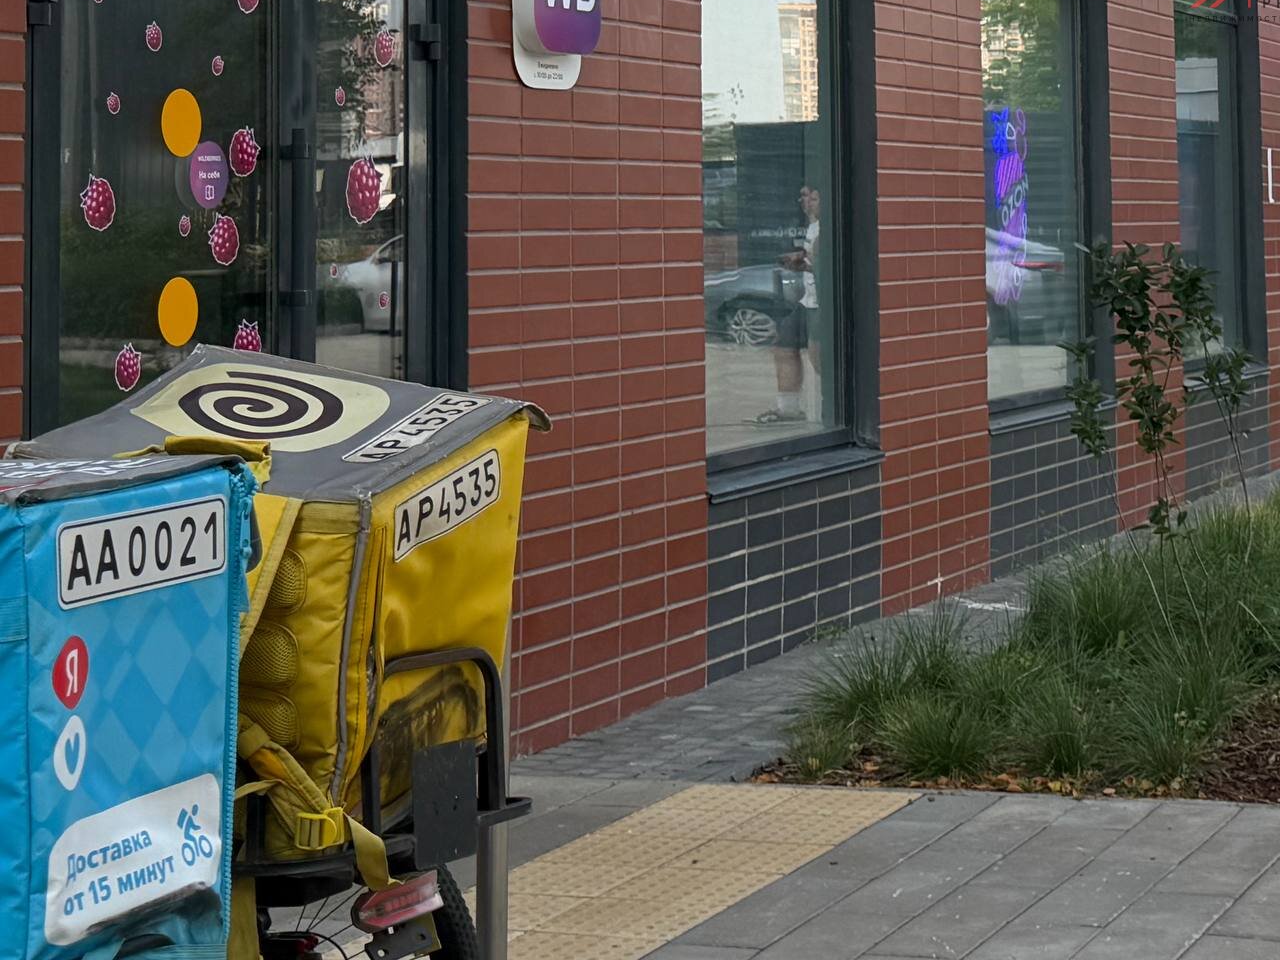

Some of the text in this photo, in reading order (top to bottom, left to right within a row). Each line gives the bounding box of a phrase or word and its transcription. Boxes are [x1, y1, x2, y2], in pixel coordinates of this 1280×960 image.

[1001, 172, 1029, 227] OZON
[397, 458, 496, 551] AP4535
[67, 511, 217, 590] AA0021
[65, 648, 79, 697] Я
[63, 855, 175, 916] от 15 минут
[66, 830, 153, 886] Доставка
